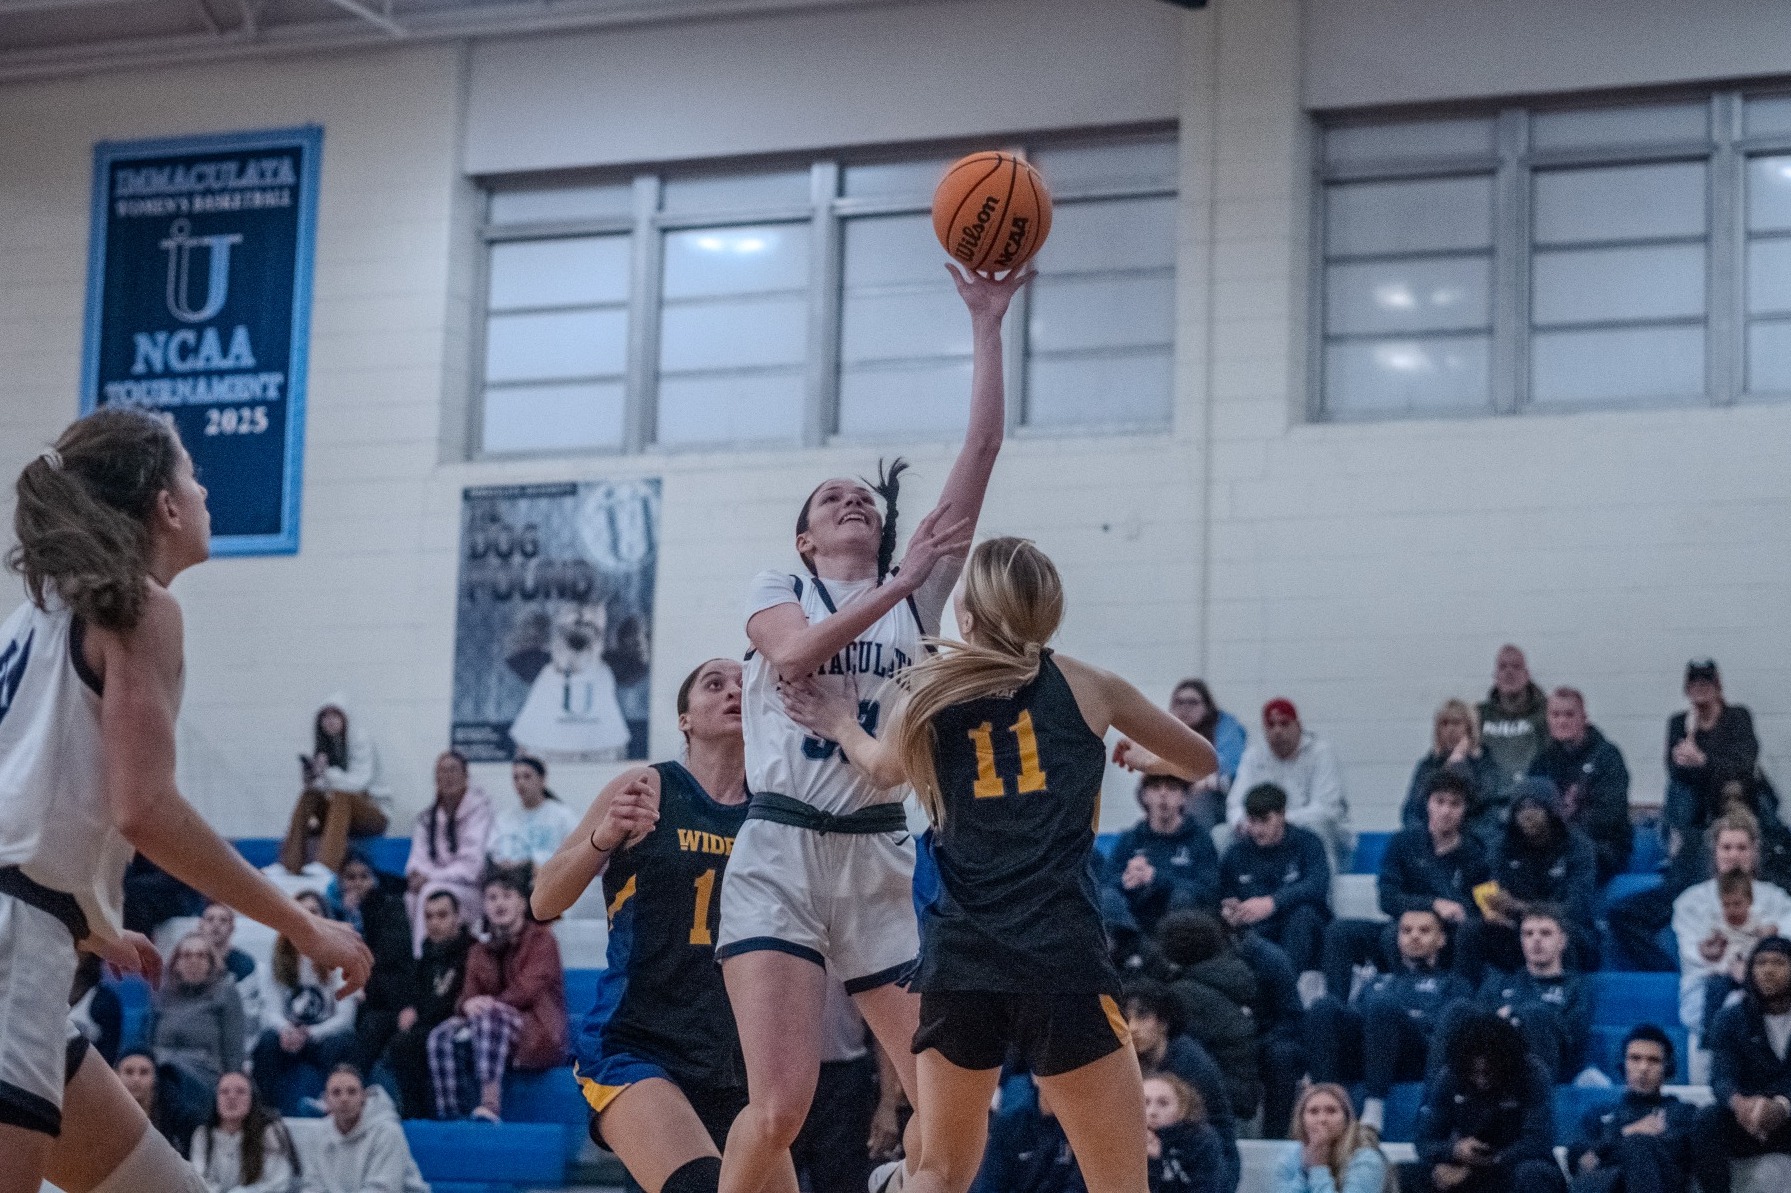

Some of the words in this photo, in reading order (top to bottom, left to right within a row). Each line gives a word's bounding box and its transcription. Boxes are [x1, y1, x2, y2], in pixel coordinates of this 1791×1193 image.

[115, 156, 296, 197] IMMACULATA
[955, 195, 1000, 262] Wilson
[994, 216, 1029, 265] NCAA
[131, 324, 256, 375] NCAA
[103, 372, 285, 409] TOURNAMENT
[204, 406, 269, 436] 2025
[967, 708, 1047, 798] 11
